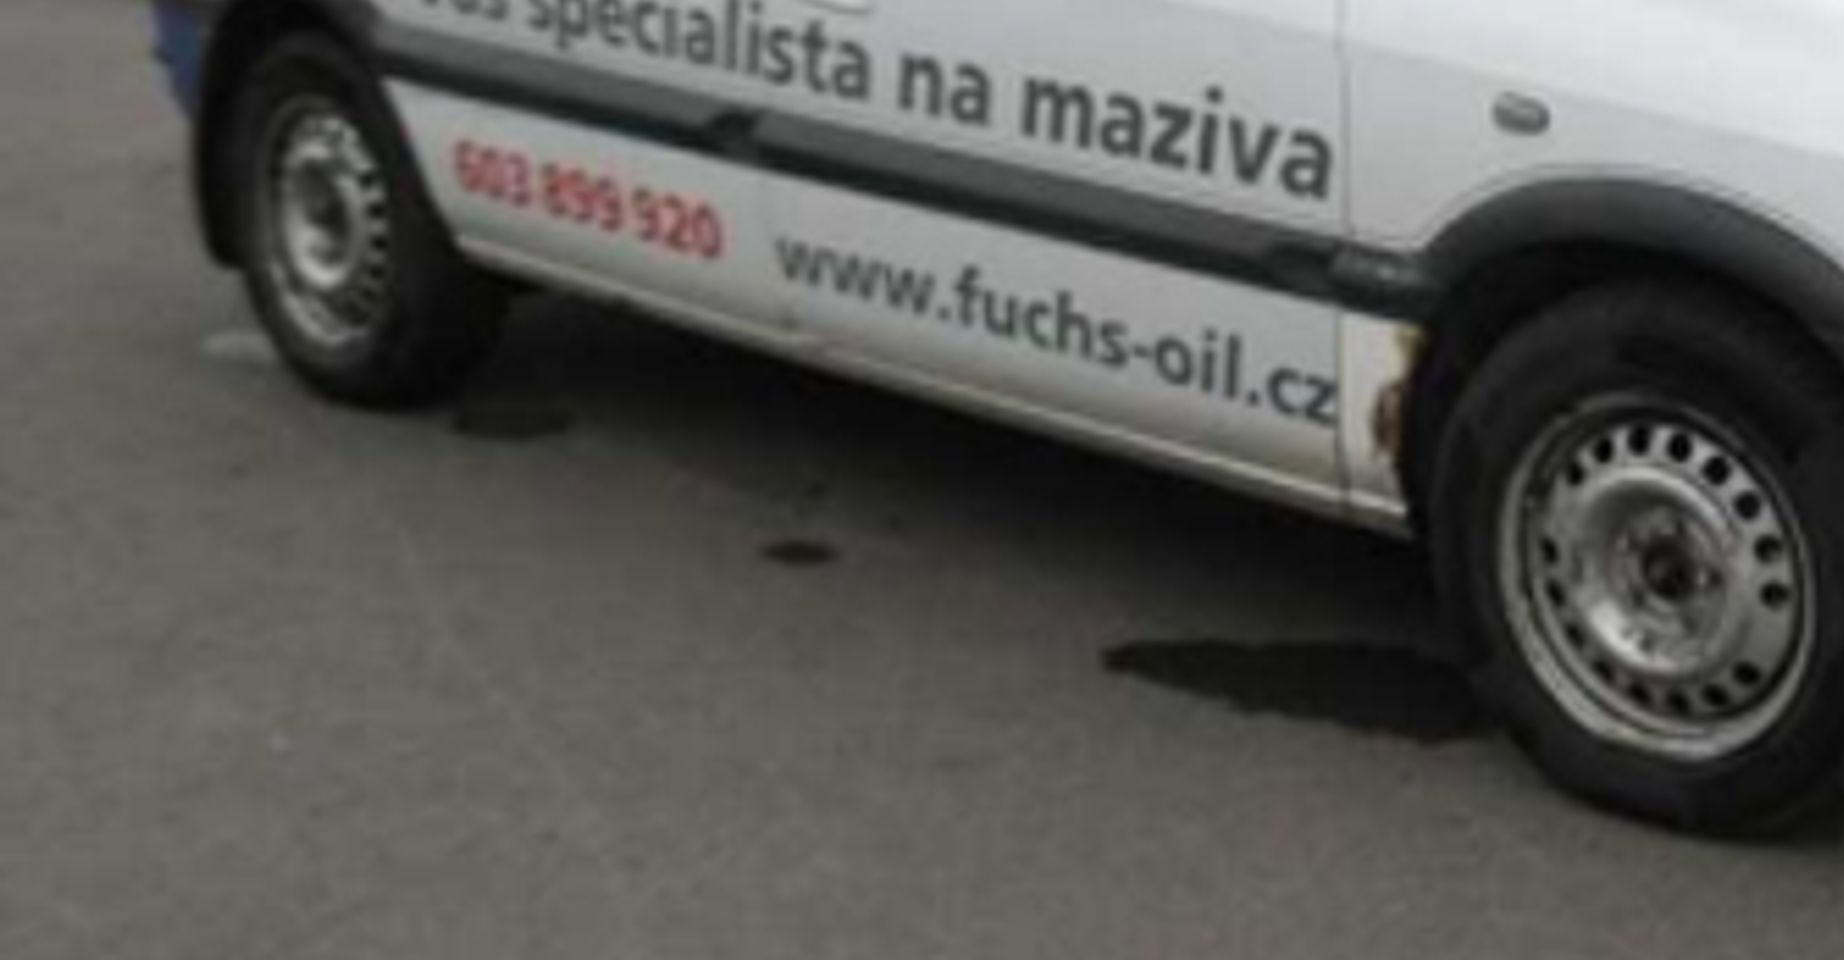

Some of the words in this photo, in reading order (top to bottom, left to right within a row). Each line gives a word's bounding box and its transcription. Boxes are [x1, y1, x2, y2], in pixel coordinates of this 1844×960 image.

[452, 139, 532, 208] 603
[541, 163, 623, 232] 899
[633, 187, 724, 260] 920
[898, 52, 992, 125] na
[1020, 74, 1333, 200] maziva
[774, 236, 1340, 427] www.fuchs-oil.cz
